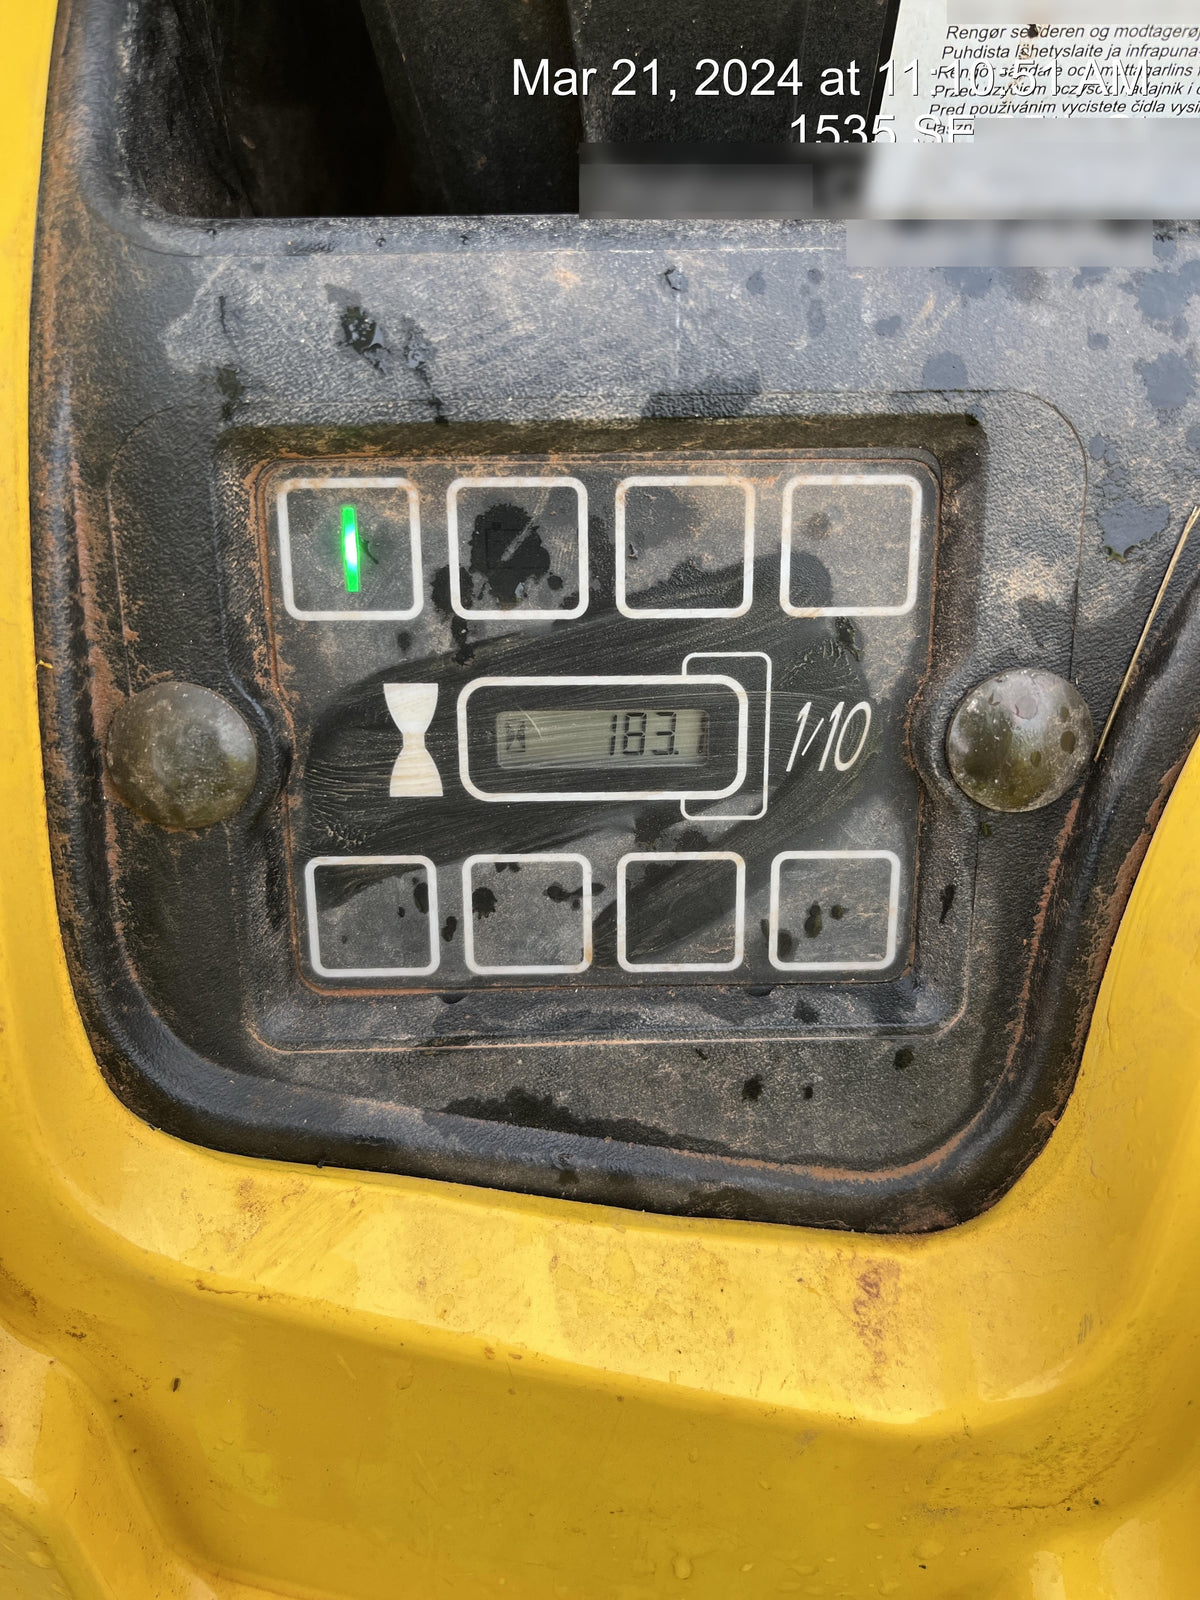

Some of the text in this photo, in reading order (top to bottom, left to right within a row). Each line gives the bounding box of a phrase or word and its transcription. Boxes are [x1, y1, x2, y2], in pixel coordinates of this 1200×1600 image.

[946, 25, 1006, 42] Rengør
[1010, 23, 1085, 39] sederen
[1089, 26, 1110, 41] og
[941, 44, 1010, 60] Puhdista
[1104, 44, 1121, 60] ja
[929, 103, 966, 116] Pred
[785, 701, 871, 773] 1/10
